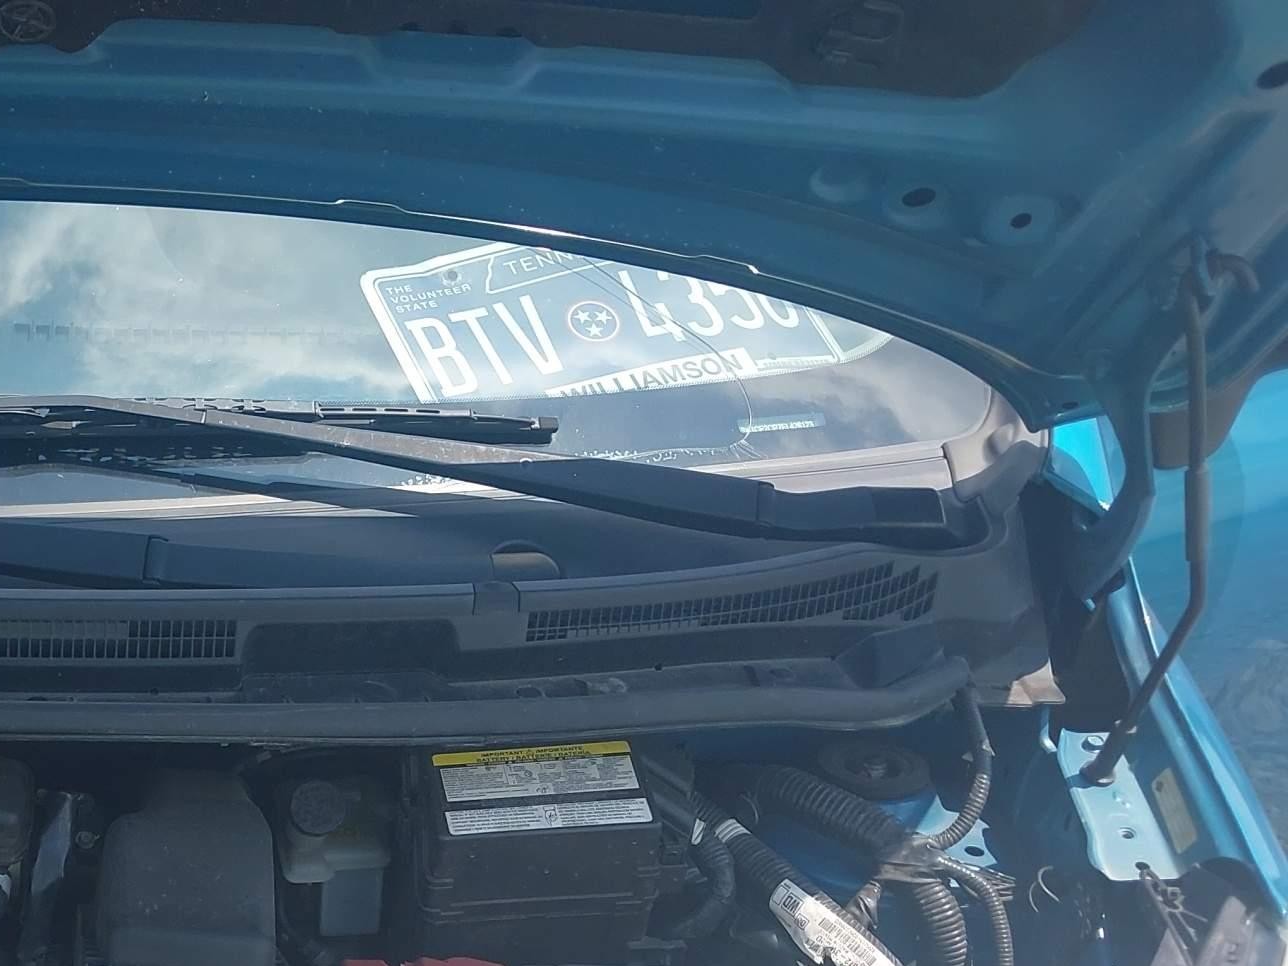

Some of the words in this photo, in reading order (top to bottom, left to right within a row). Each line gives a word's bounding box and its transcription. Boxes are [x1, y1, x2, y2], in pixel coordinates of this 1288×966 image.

[385, 284, 413, 295] THE
[390, 283, 472, 304] VOLUNTEER
[395, 300, 439, 313] STATE
[404, 294, 564, 397] BTV
[783, 895, 801, 914] WD
